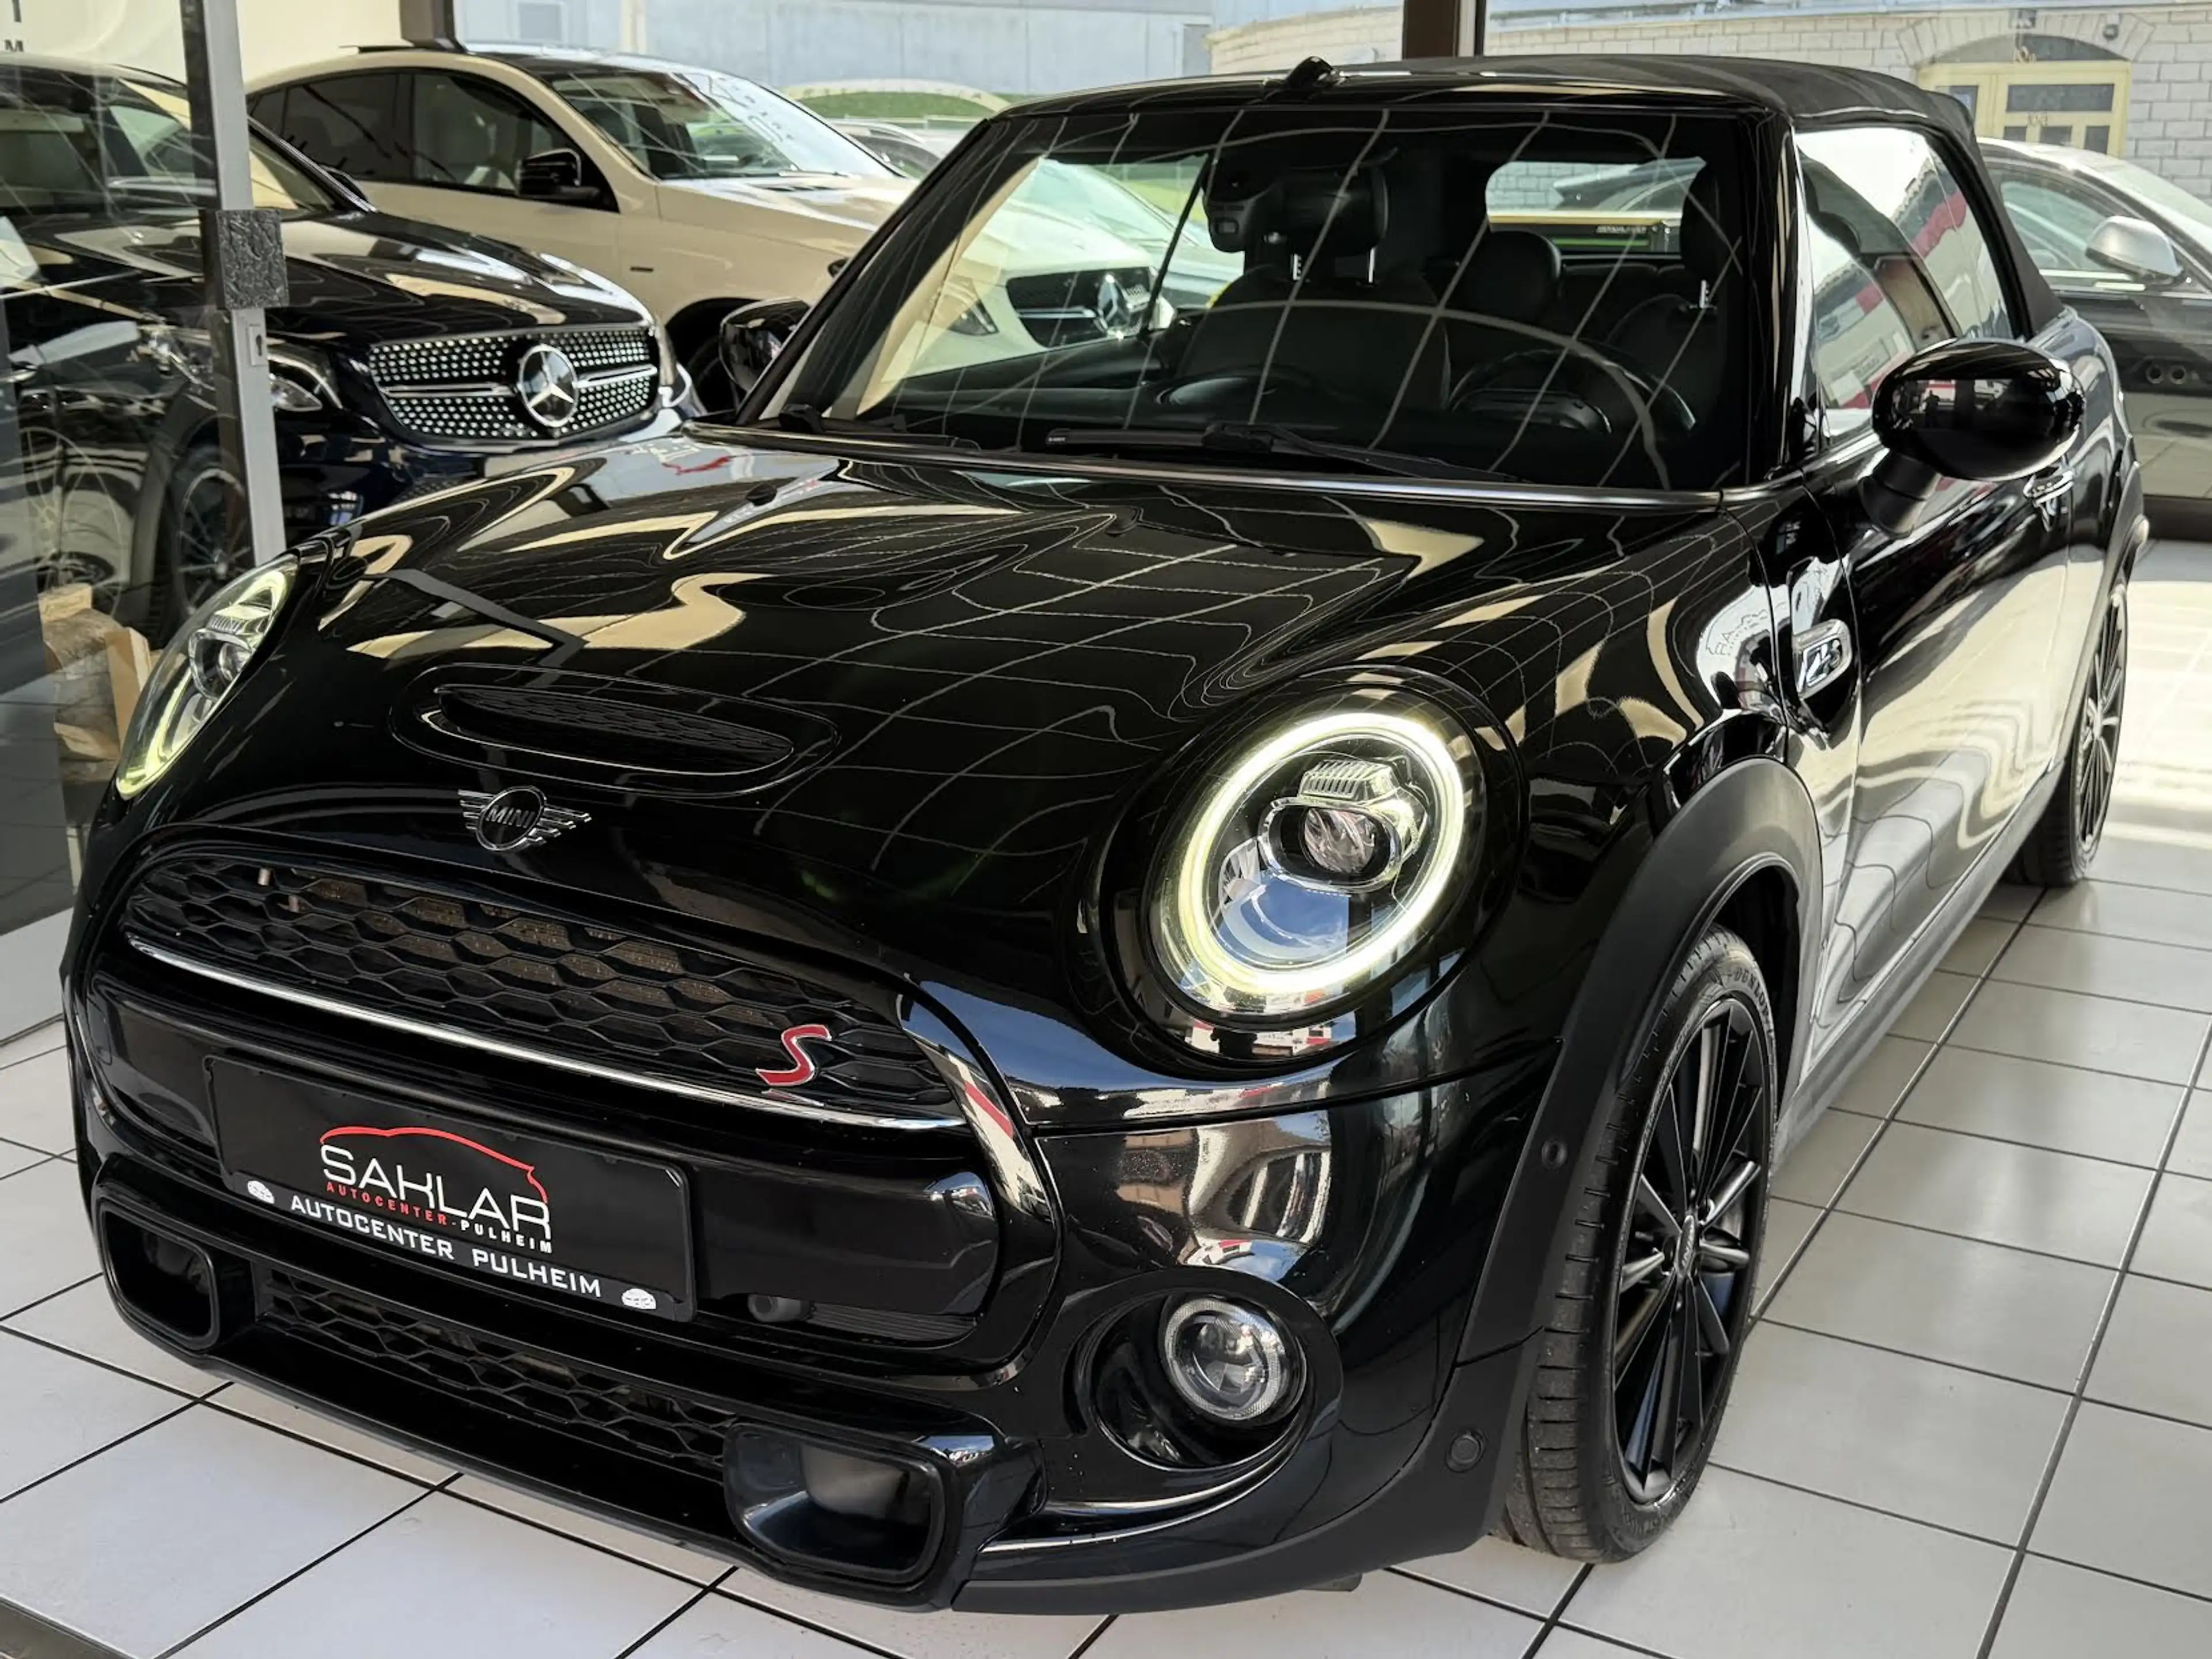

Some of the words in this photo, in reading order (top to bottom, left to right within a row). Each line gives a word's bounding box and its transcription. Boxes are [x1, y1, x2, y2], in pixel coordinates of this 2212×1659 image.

[486, 804, 535, 828] MINI
[755, 1024, 832, 1086] S
[320, 1145, 551, 1240] SAHLAR
[290, 1195, 455, 1260] AUTOCENTER
[471, 1248, 601, 1298] PULHEIM
